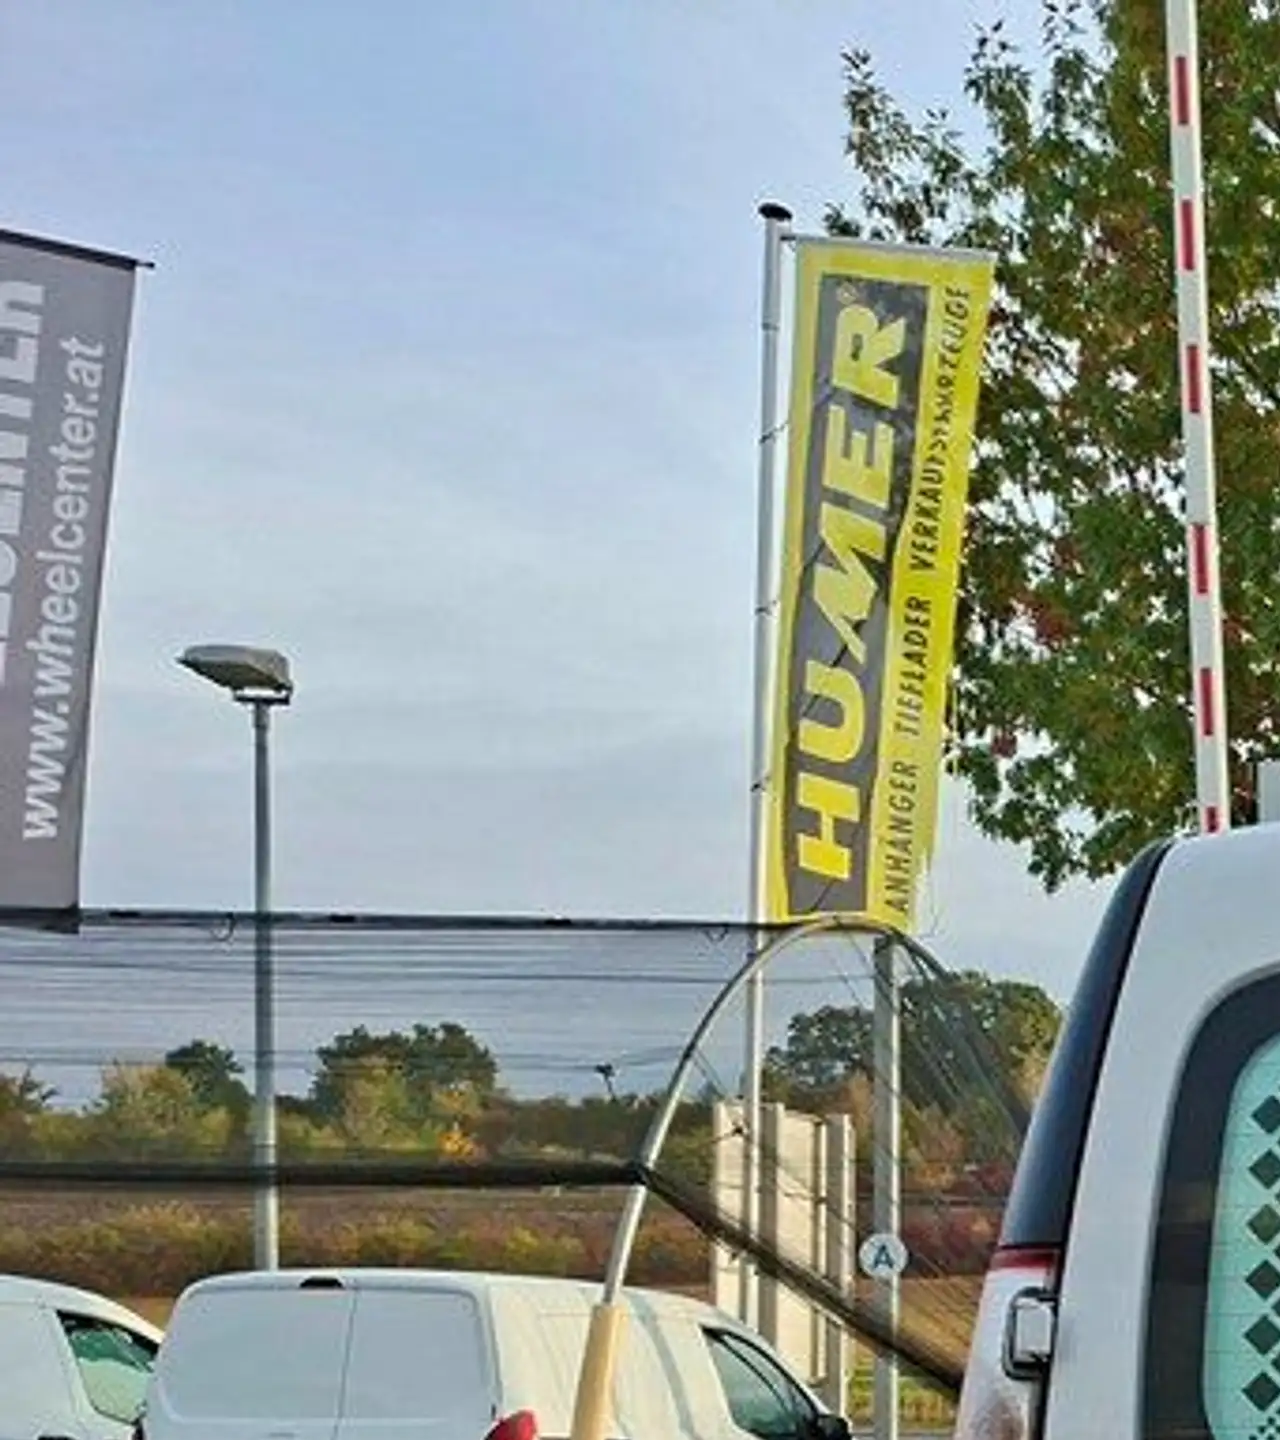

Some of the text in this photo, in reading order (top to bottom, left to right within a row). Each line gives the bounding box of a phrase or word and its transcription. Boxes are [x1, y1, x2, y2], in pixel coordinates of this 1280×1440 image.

[22, 335, 106, 842] www.wheelcenter.at
[799, 304, 908, 881] HUMER
[893, 596, 933, 737] TIEFLADER
[873, 1244, 896, 1269] A
